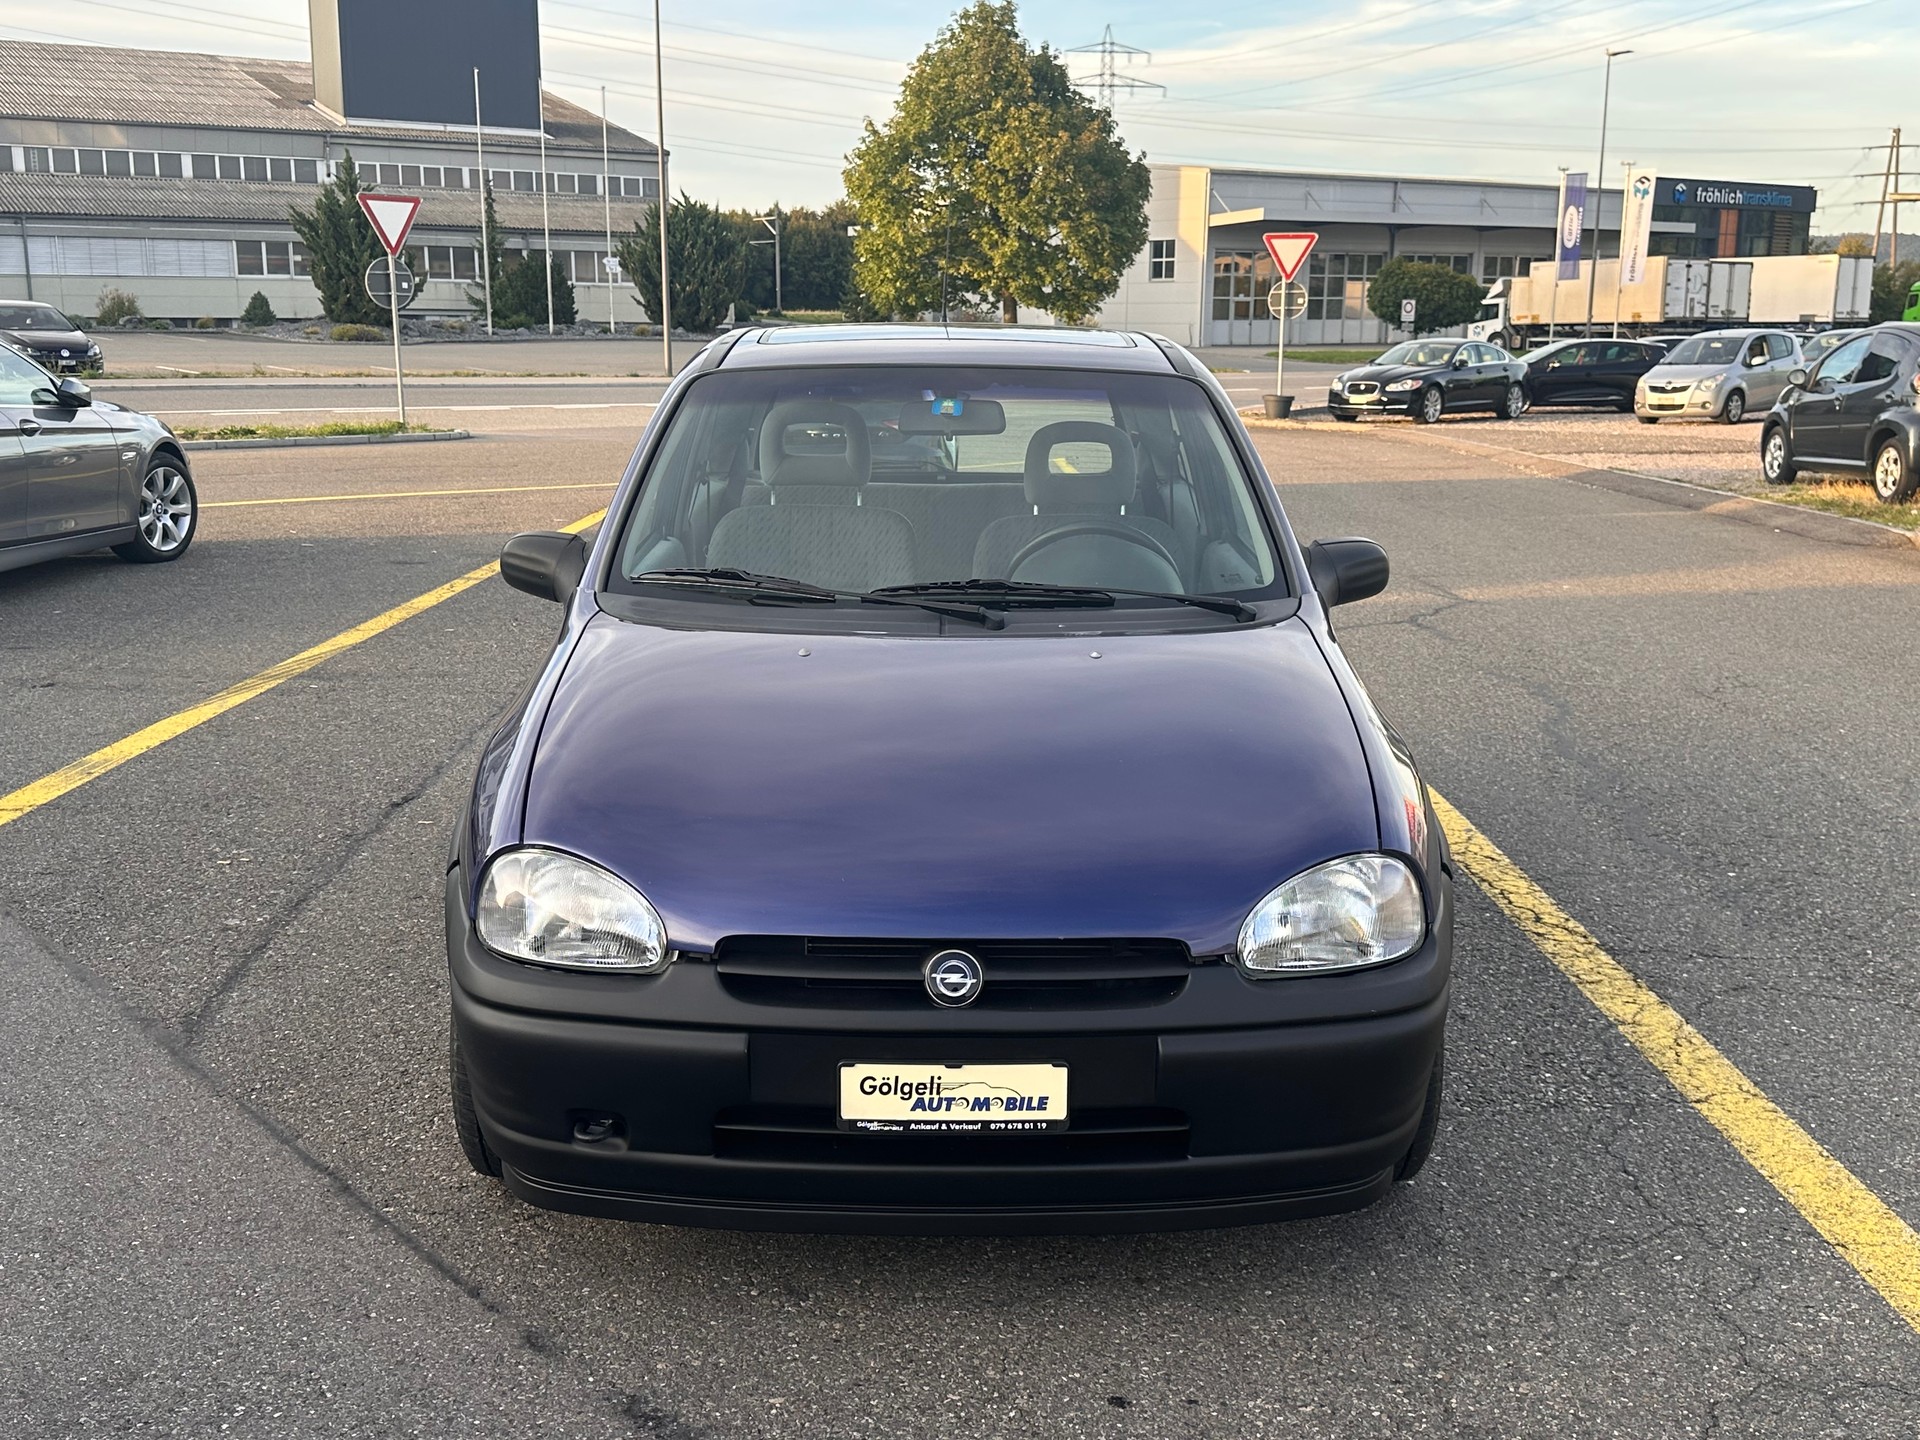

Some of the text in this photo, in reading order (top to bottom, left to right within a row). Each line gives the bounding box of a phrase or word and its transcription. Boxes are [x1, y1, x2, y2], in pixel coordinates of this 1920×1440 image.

[859, 1075, 942, 1100] Gölgeli
[910, 1096, 1049, 1112] AUTOMOBILE
[909, 1122, 939, 1130] Ankauf
[949, 1122, 981, 1130] Verkauf
[990, 1122, 1006, 1130] 079
[1007, 1122, 1023, 1130] 678
[1024, 1122, 1034, 1130] 01
[1037, 1122, 1047, 1130] 19
